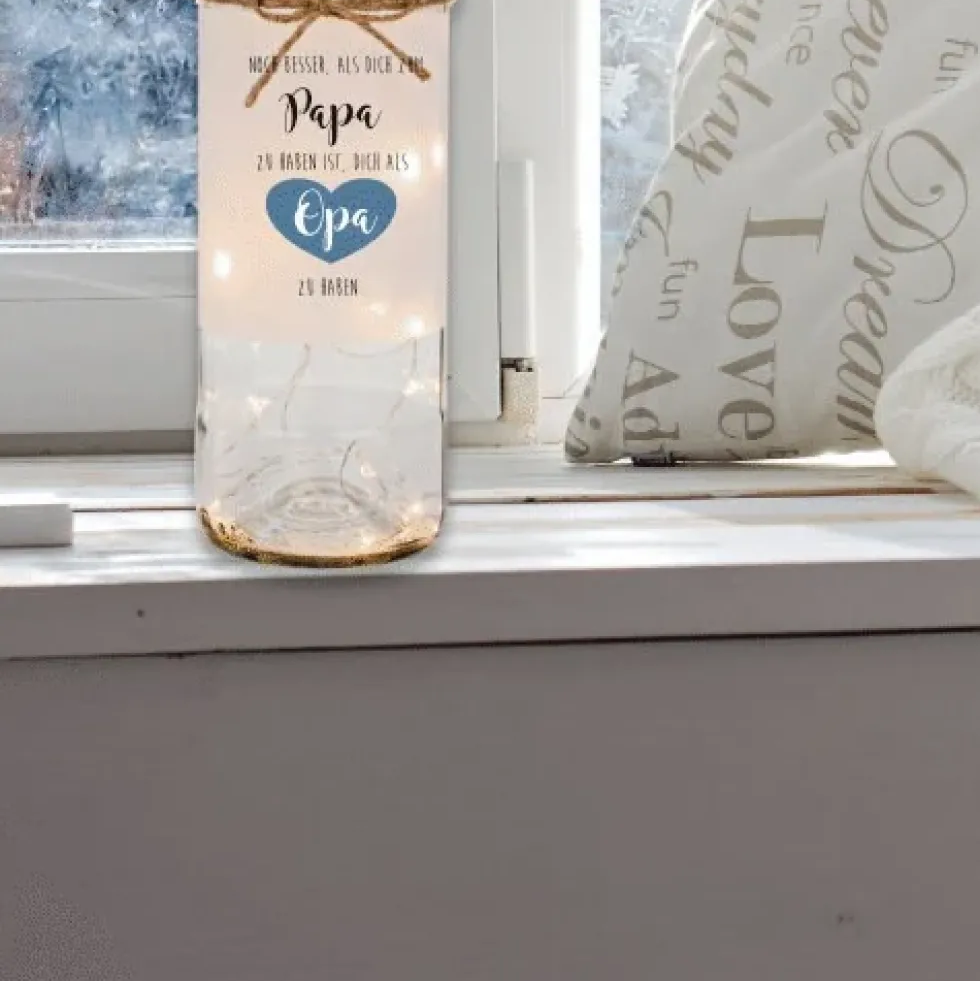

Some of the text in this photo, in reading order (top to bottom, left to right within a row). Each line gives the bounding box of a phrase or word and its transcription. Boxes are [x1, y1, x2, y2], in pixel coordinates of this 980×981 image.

[284, 54, 329, 76] BESSER,
[337, 54, 360, 73] ALS
[364, 54, 393, 73] DICH
[278, 86, 383, 147] Papa
[257, 153, 273, 171] ZU
[280, 152, 317, 171] HABEN
[354, 152, 380, 171] DICH
[387, 152, 409, 171] ALS
[294, 188, 379, 252] Opa
[298, 278, 358, 297] ZU HABEN
[656, 258, 698, 321] fun
[716, 199, 829, 442] Love
